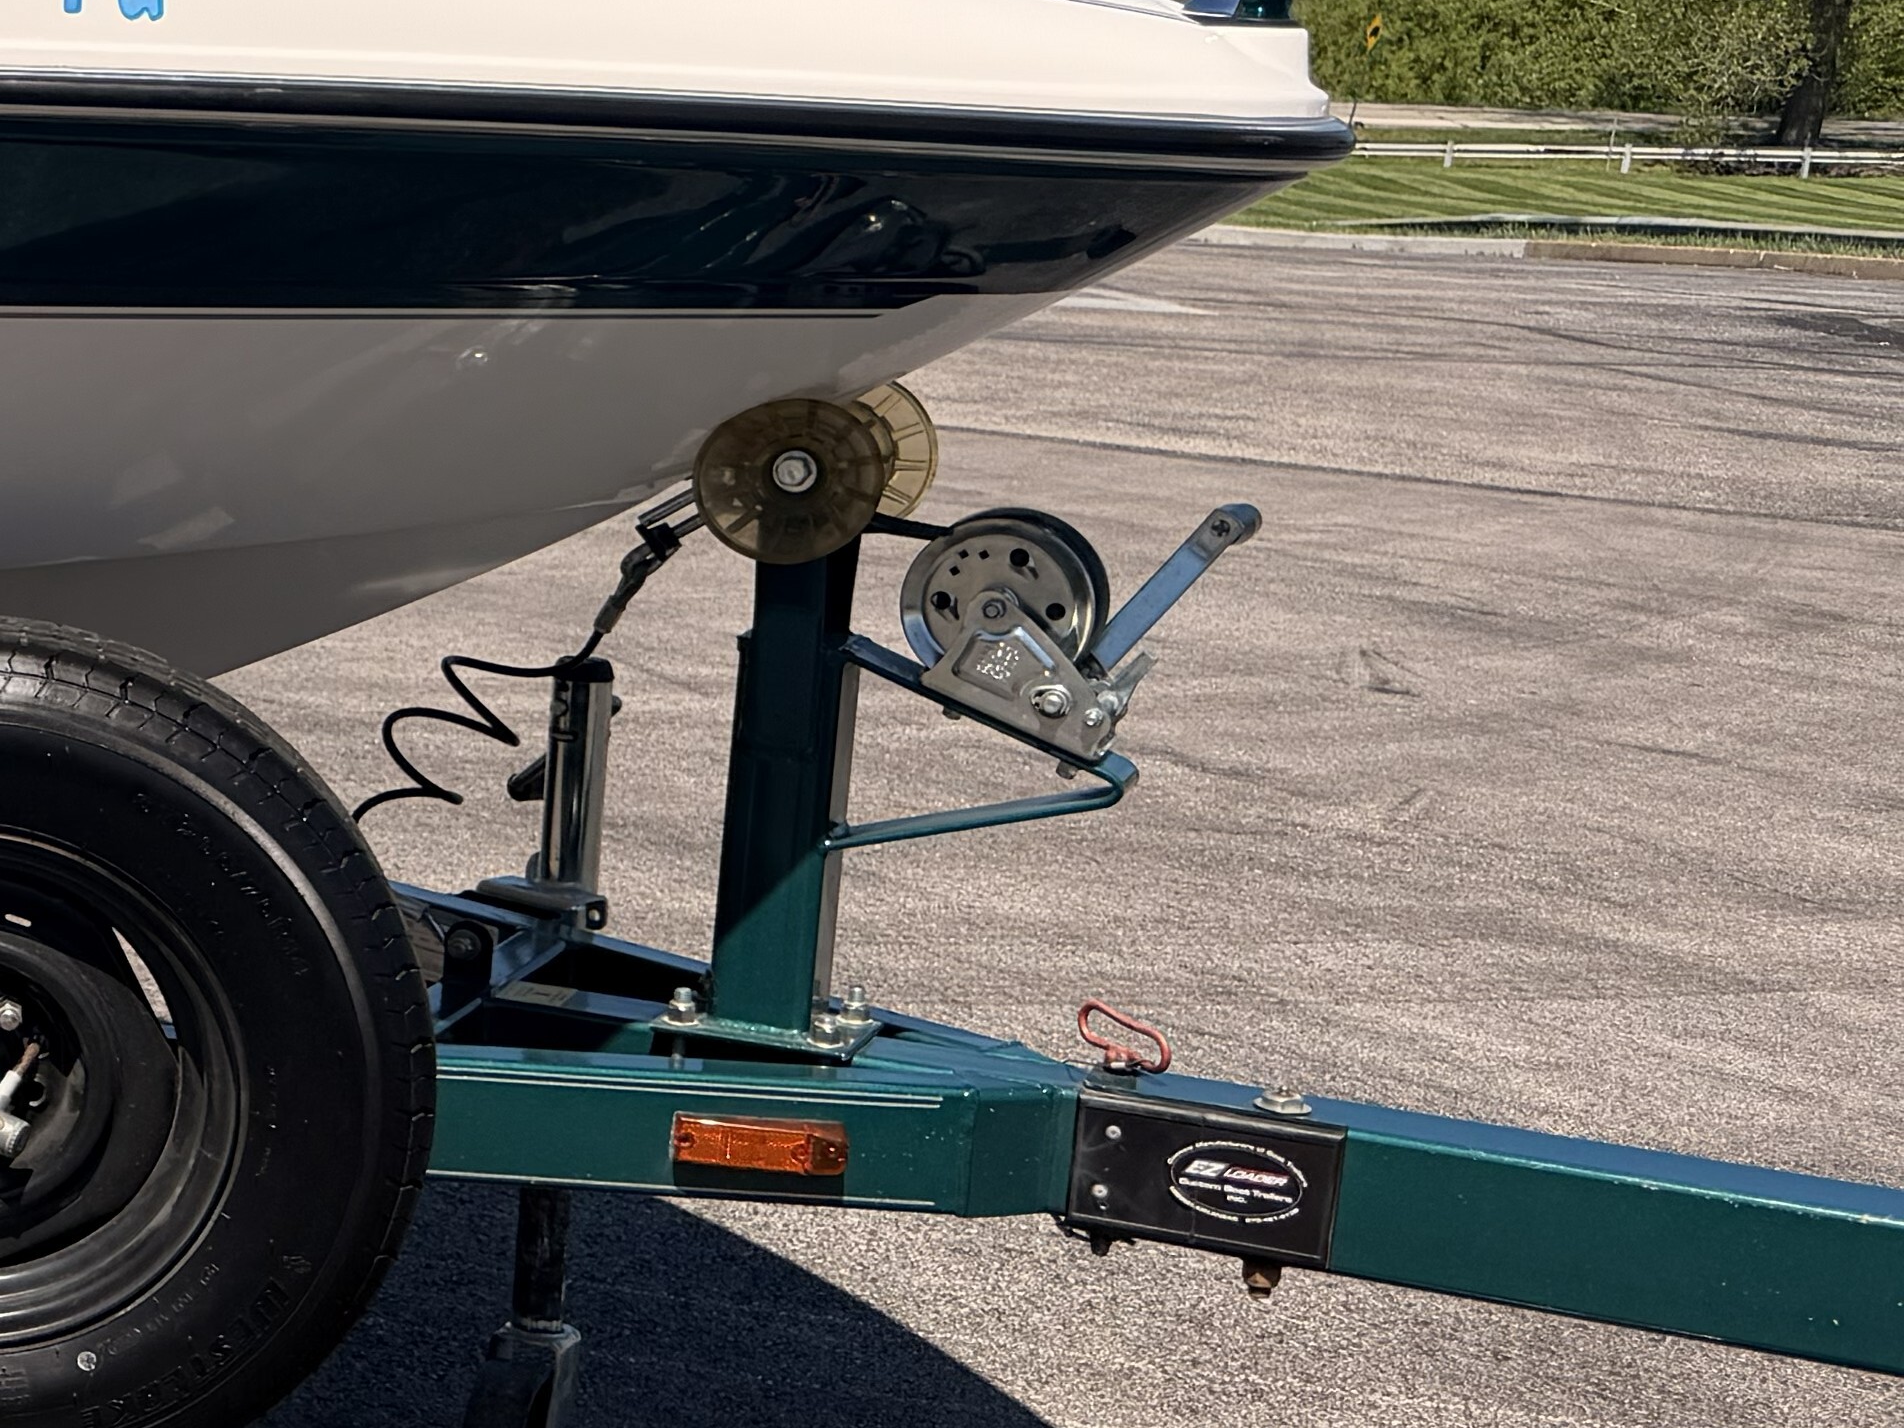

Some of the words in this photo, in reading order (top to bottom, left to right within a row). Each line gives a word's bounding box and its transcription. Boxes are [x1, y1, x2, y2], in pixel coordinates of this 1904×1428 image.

[1183, 1159, 1229, 1178] EZ
[1223, 1167, 1290, 1188] LOADER
[1223, 1183, 1251, 1197] Boat
